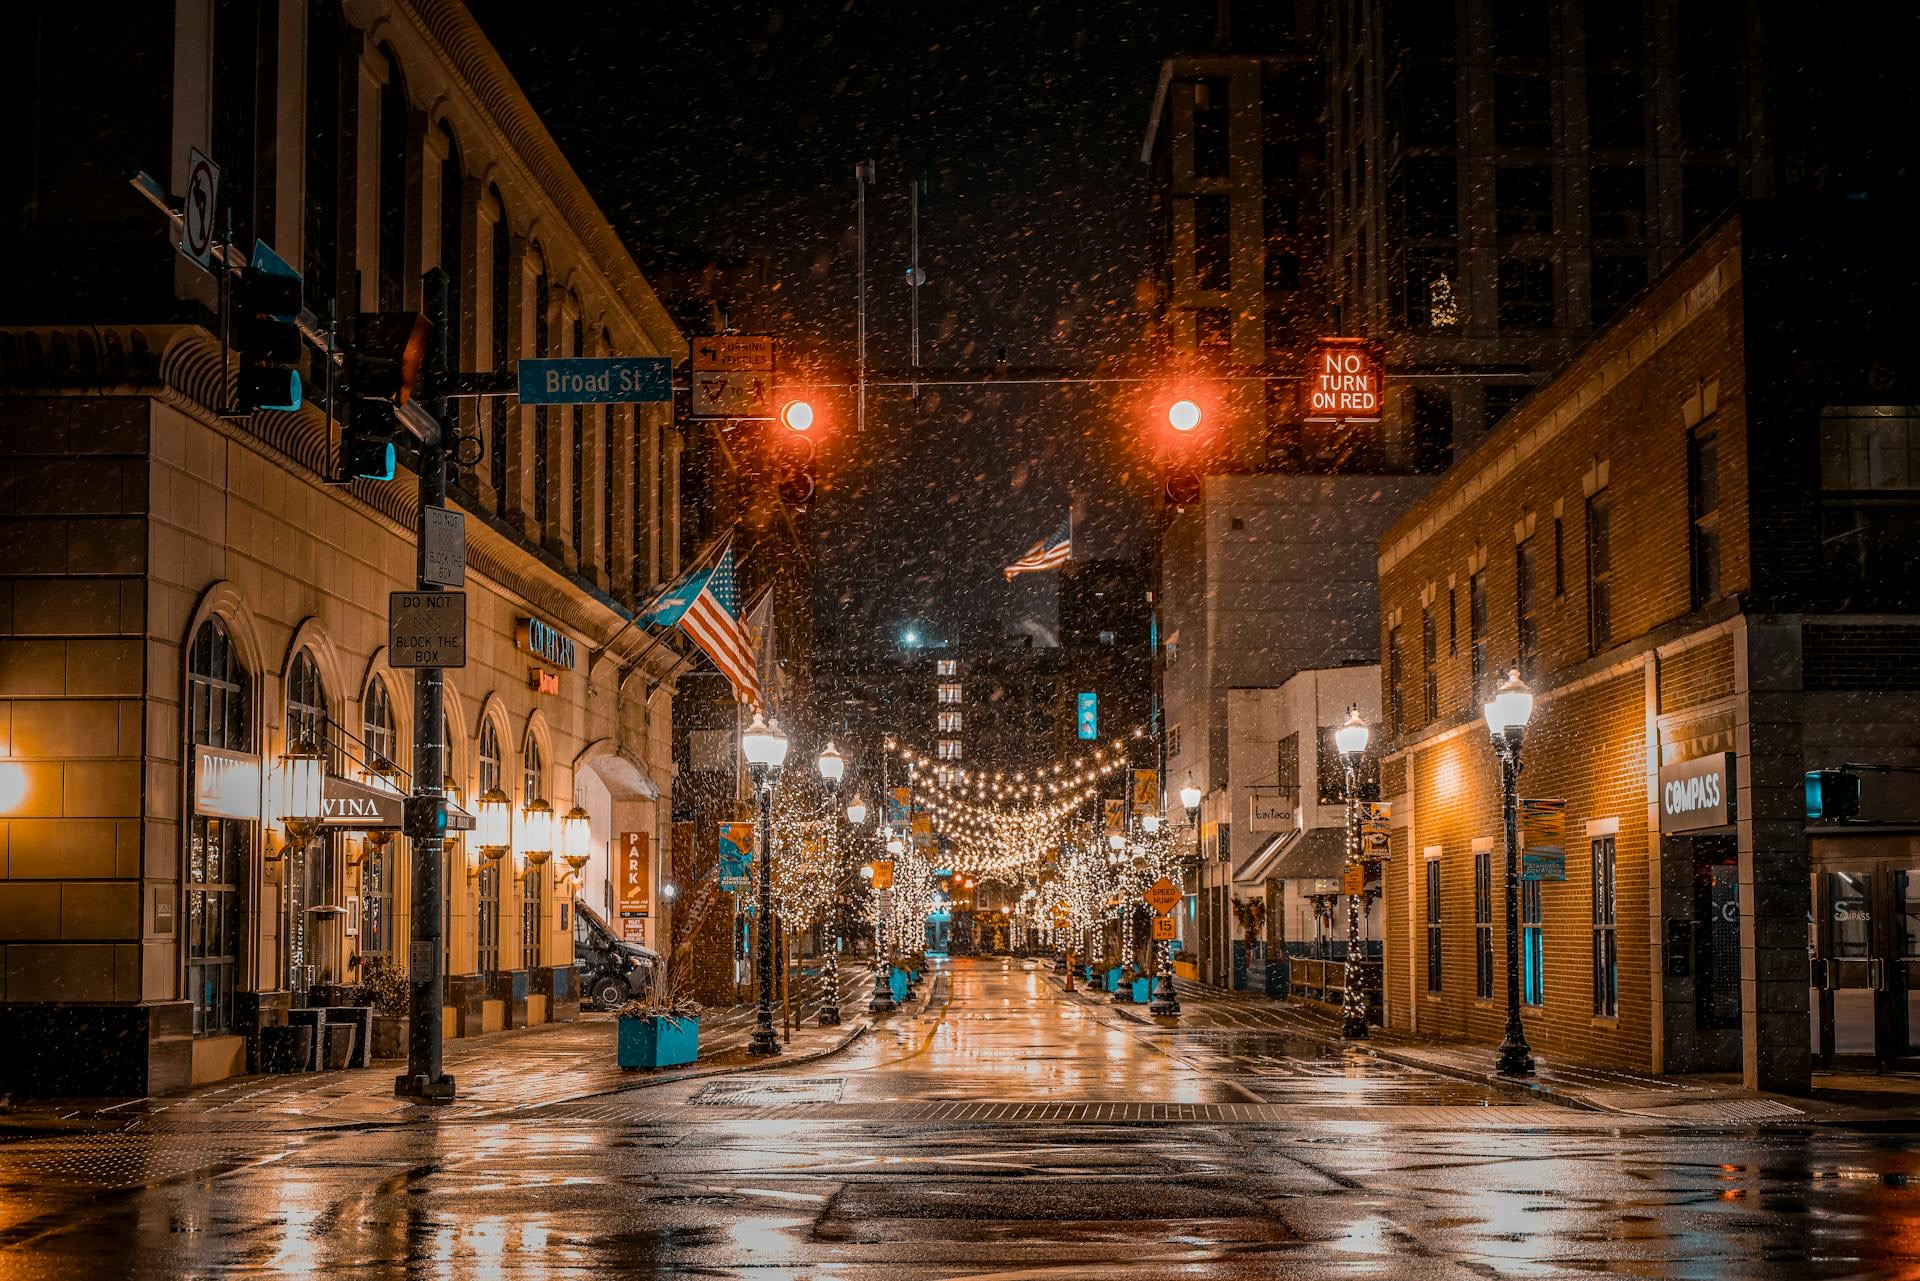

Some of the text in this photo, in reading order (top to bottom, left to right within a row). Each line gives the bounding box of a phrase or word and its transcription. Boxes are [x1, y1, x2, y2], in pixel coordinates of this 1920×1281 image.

[721, 342, 766, 352] TURNING
[721, 355, 768, 365] VEHICLES
[1326, 354, 1361, 374] NO
[545, 368, 642, 394] Broad St
[1320, 375, 1367, 391] TURN
[731, 387, 743, 397] TO
[1313, 392, 1375, 409] ON RED
[432, 512, 458, 527] DO NOT
[430, 551, 462, 567] BLOCK THE
[439, 567, 452, 580] BOX
[403, 596, 452, 608] DO NOT
[396, 636, 459, 648] BLOCK THE
[415, 651, 439, 663] BOX
[1664, 772, 1720, 815] COMPASS
[1256, 806, 1291, 820] bartaco
[628, 832, 640, 885] PARK
[1152, 888, 1176, 896] SPEED
[1153, 896, 1175, 904] HUMP
[1834, 912, 1871, 922] COMPASS
[1158, 920, 1172, 931] 15
